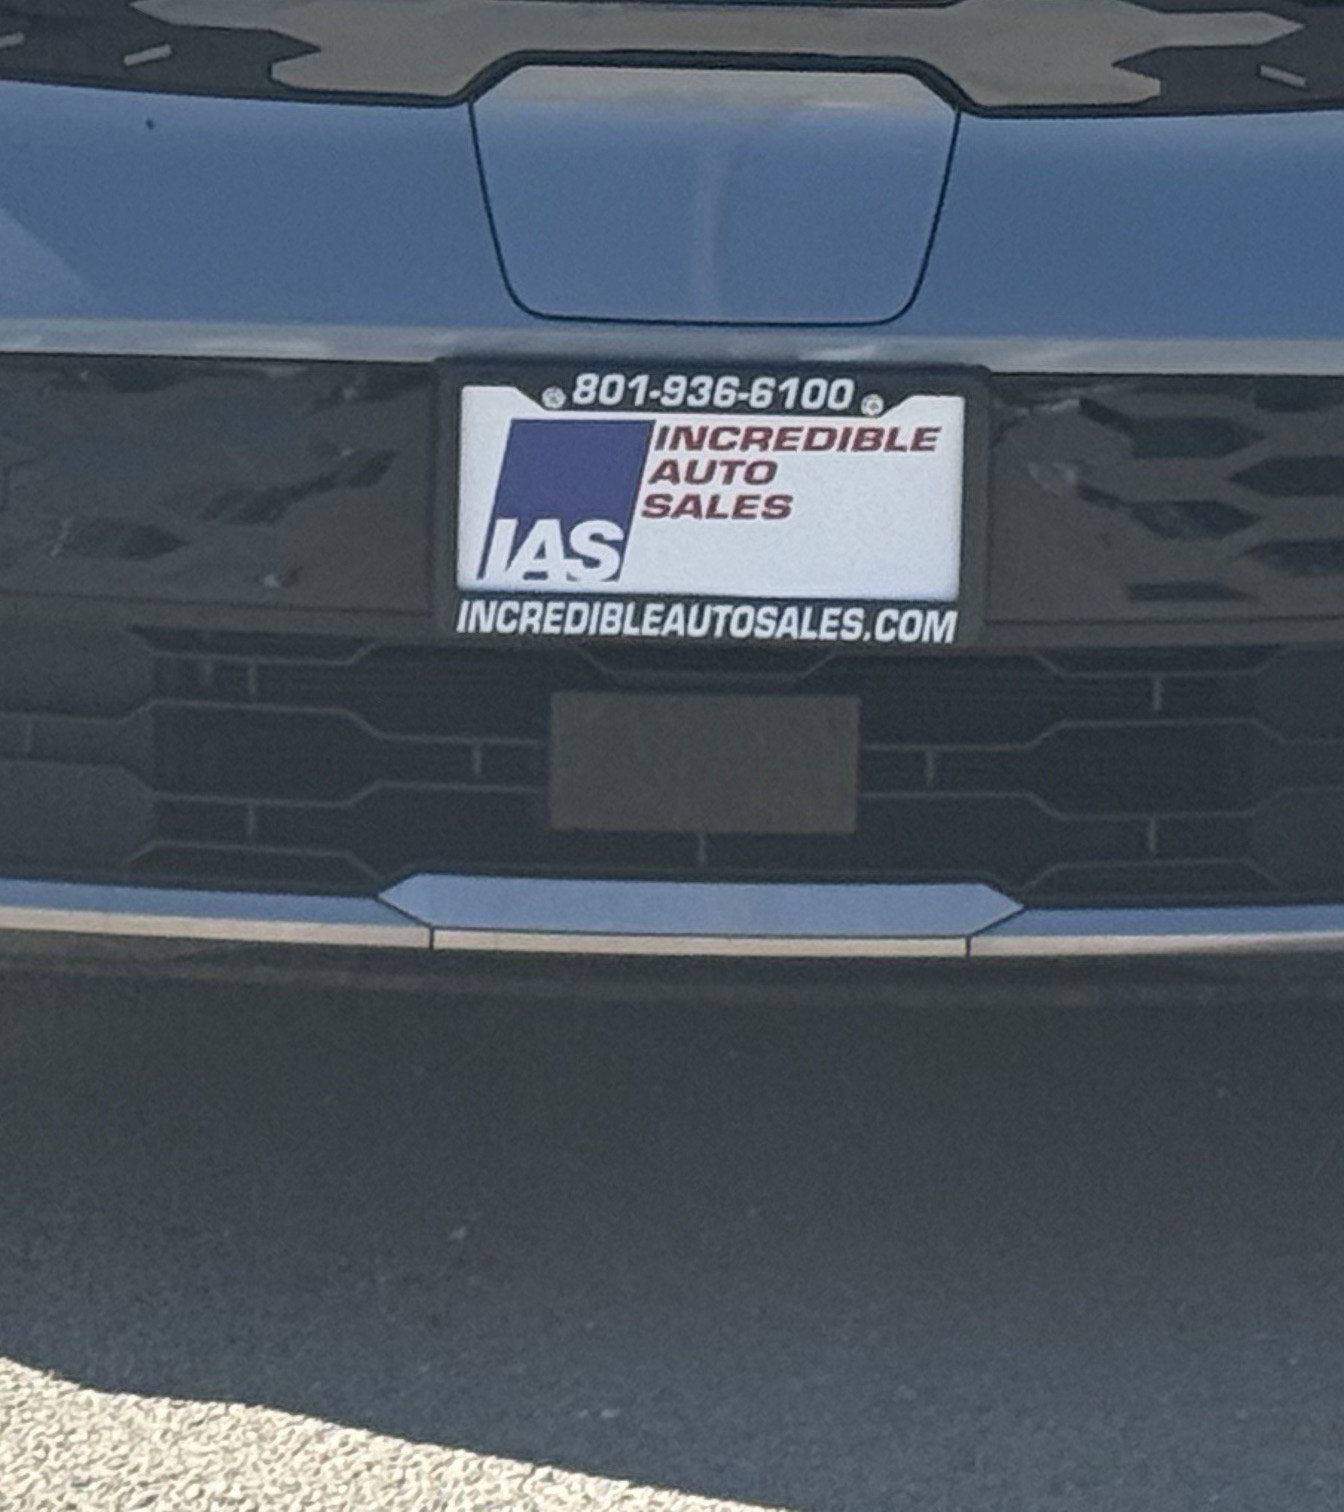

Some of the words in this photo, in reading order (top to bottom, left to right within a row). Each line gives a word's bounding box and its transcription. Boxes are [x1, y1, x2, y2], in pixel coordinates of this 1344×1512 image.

[572, 373, 855, 410] 801-936-6100
[654, 425, 942, 452] INCREDIBLE
[648, 460, 778, 485] AUTO
[641, 493, 793, 520] SALES
[485, 517, 624, 582] IAS
[456, 600, 958, 644] INCREDIBLEAUTOSALES.COM
